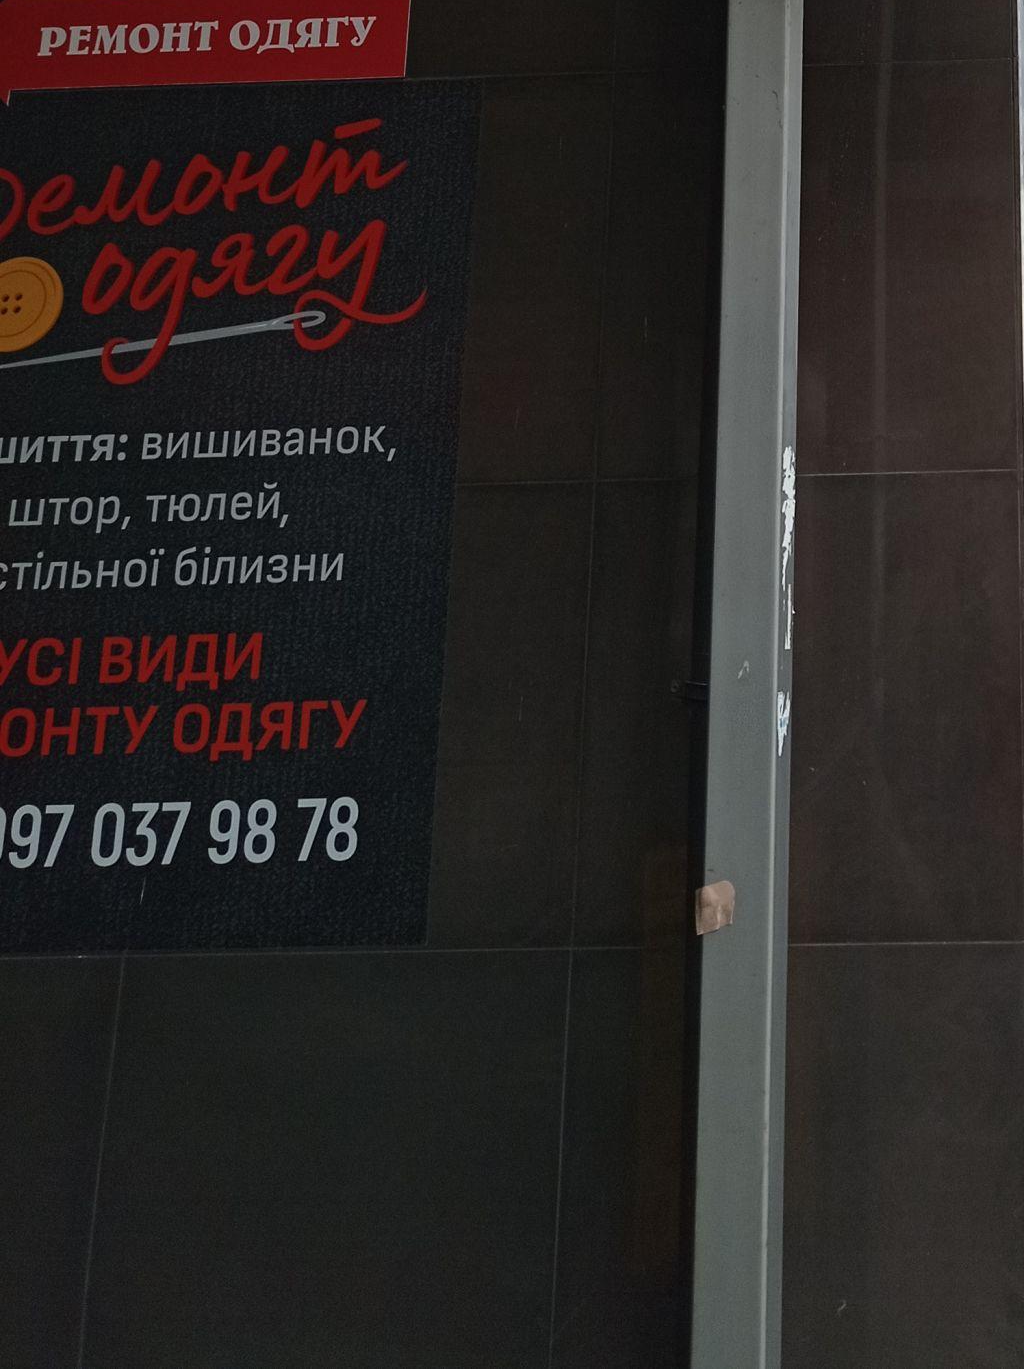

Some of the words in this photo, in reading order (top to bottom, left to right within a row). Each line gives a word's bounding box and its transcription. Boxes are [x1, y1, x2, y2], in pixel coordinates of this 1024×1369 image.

[37, 20, 219, 57] РЕМОНТ
[229, 15, 377, 54] ОДЯГУ
[82, 219, 428, 385] одягу
[142, 424, 397, 462] вишиванок,
[8, 494, 132, 533] штор,
[146, 481, 289, 528] тюлей,
[174, 545, 345, 587] білизни
[0, 637, 84, 686] УСІ
[99, 631, 264, 692] ВИДИ
[172, 698, 368, 763] ОДЯГУ
[0, 803, 75, 869] 97
[91, 800, 192, 868] 037
[207, 798, 278, 865] 98
[297, 795, 360, 863] 78
